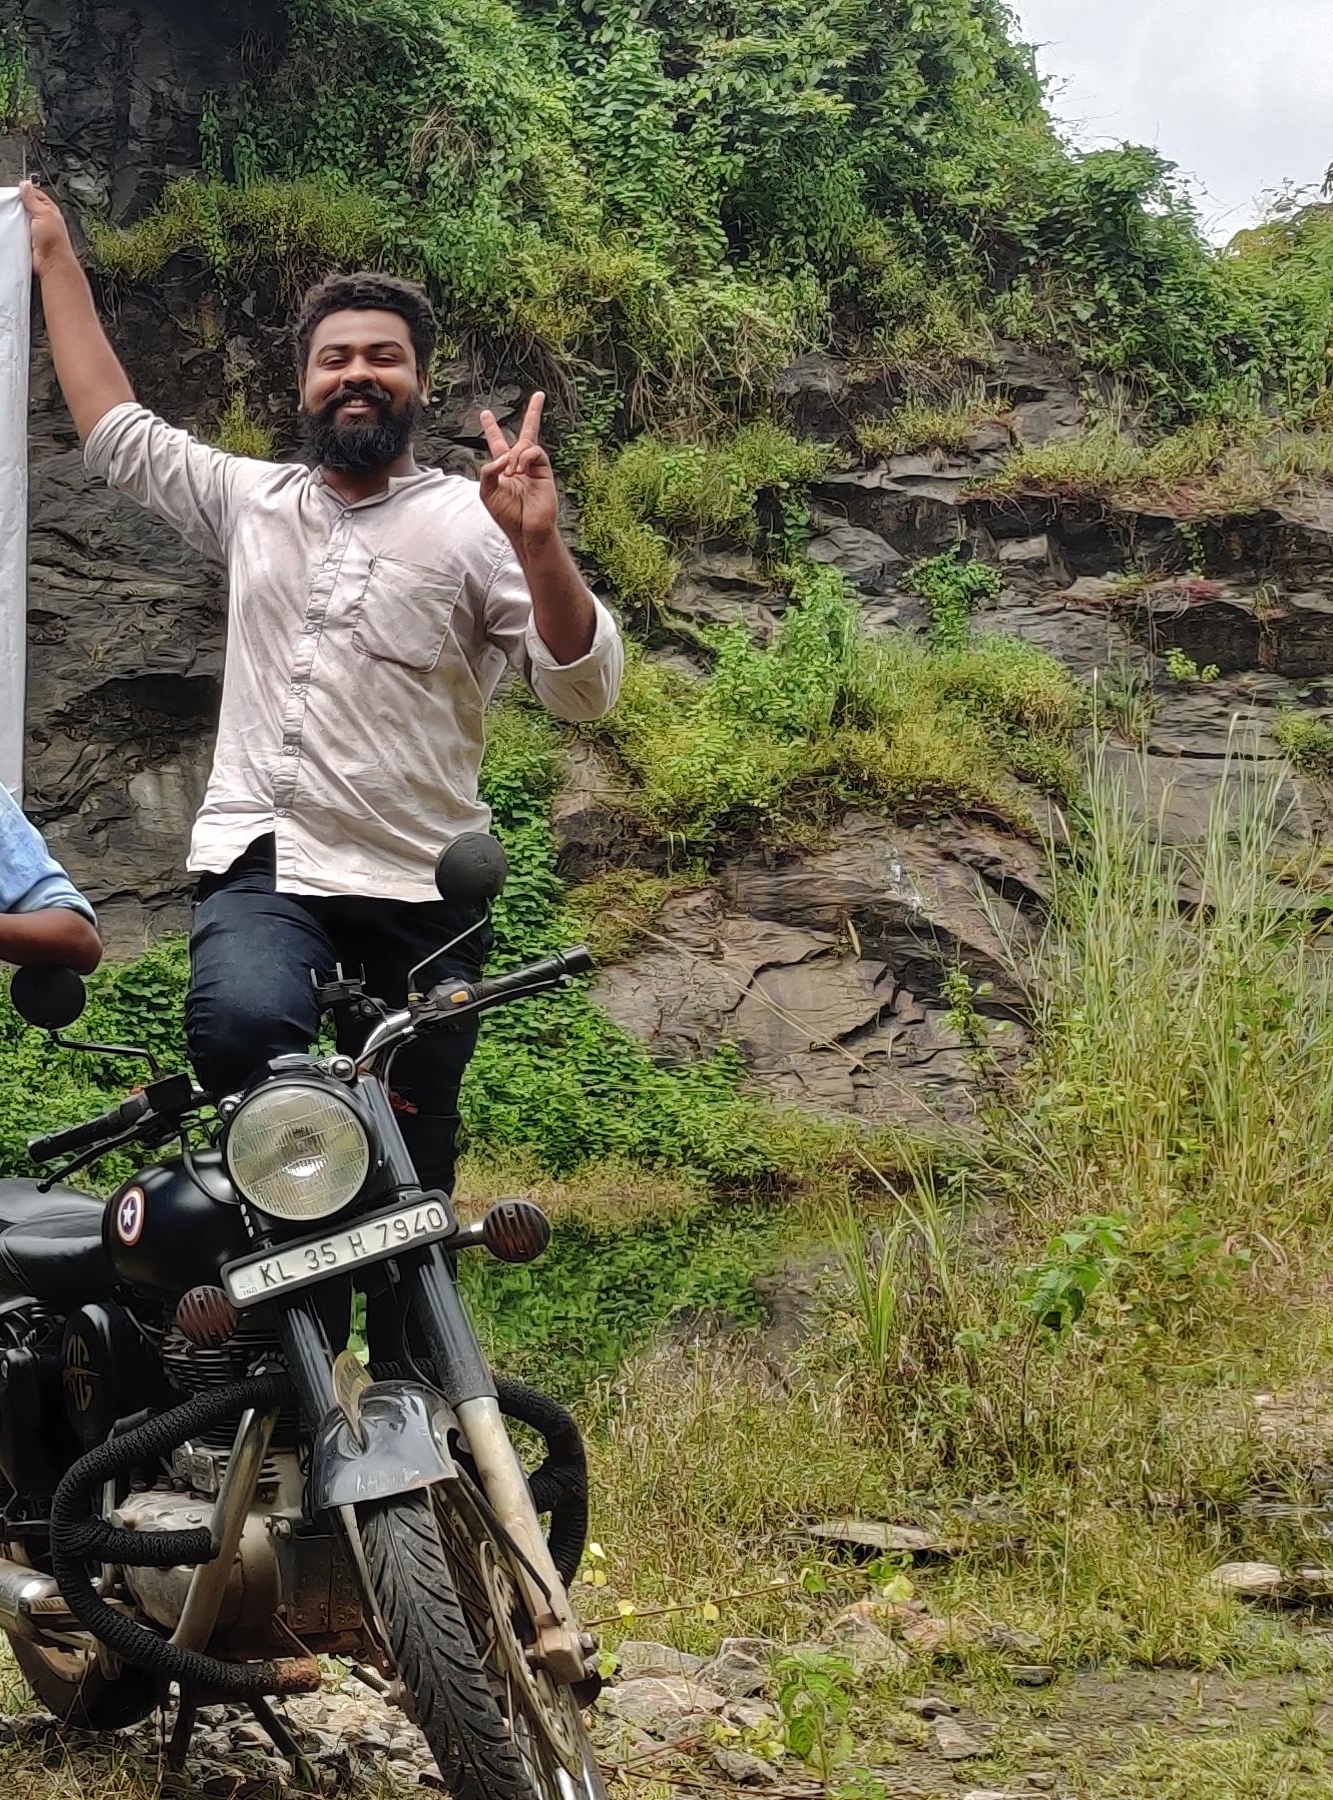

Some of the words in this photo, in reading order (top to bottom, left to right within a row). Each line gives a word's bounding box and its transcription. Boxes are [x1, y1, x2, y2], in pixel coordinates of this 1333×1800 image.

[258, 1259, 296, 1288] KL
[303, 1241, 338, 1270] 35
[347, 1231, 368, 1258] H
[374, 1206, 444, 1249] 7940
